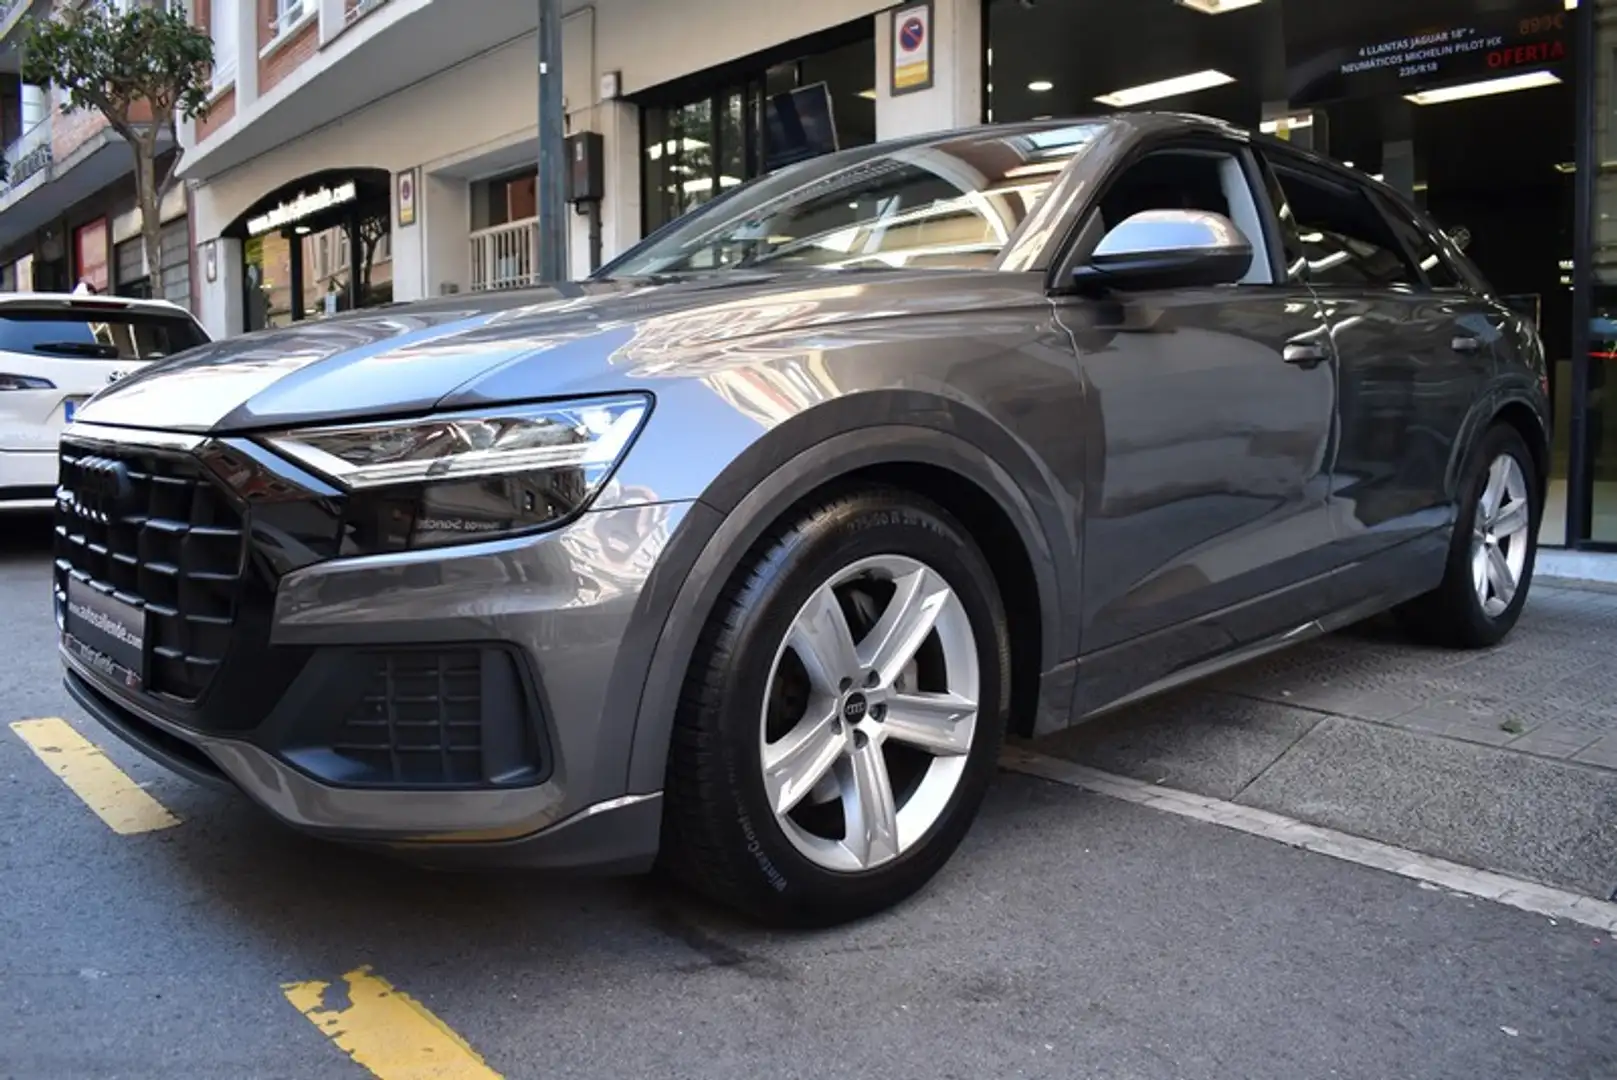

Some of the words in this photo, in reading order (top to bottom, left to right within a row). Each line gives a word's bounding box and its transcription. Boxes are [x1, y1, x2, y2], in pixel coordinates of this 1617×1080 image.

[1366, 39, 1409, 56] LLANTAS
[1410, 31, 1448, 50] JAGUAR
[1405, 44, 1453, 62] MICHELIN
[1455, 39, 1485, 52] PILOT
[1487, 41, 1565, 68] OFERTA
